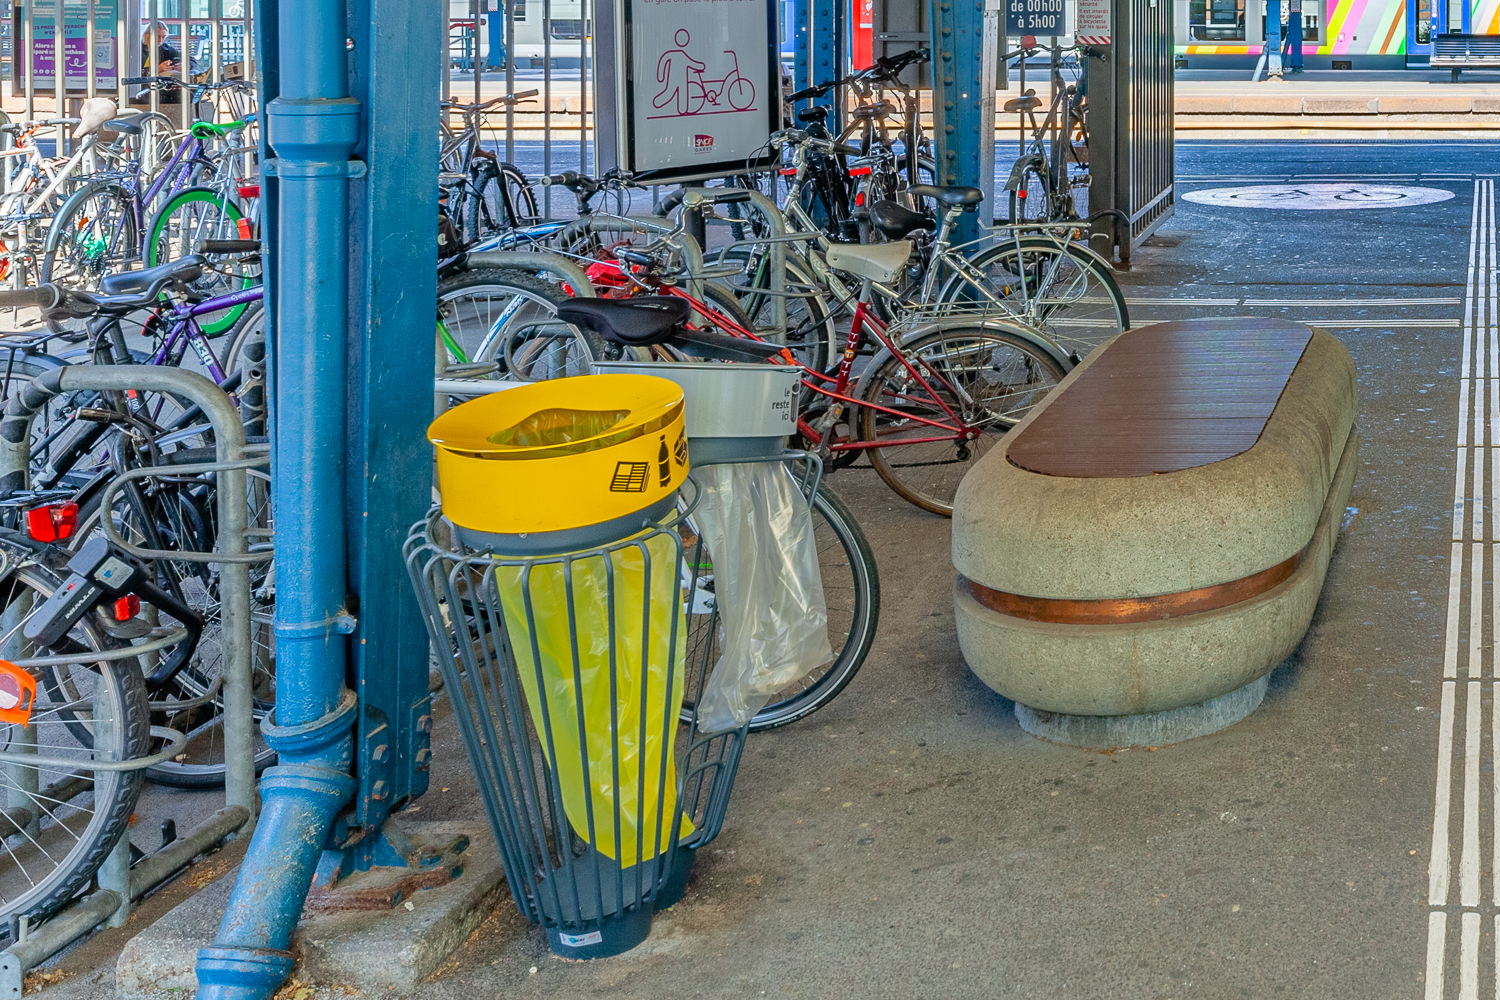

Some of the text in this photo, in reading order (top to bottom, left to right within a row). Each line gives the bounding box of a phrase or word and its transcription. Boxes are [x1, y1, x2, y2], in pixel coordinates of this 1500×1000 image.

[1018, 14, 1055, 28] à 5h00
[695, 137, 713, 147] SNCF
[194, 337, 214, 367] 830
[784, 388, 790, 397] le
[772, 401, 790, 409] reste
[782, 411, 790, 421] ici
